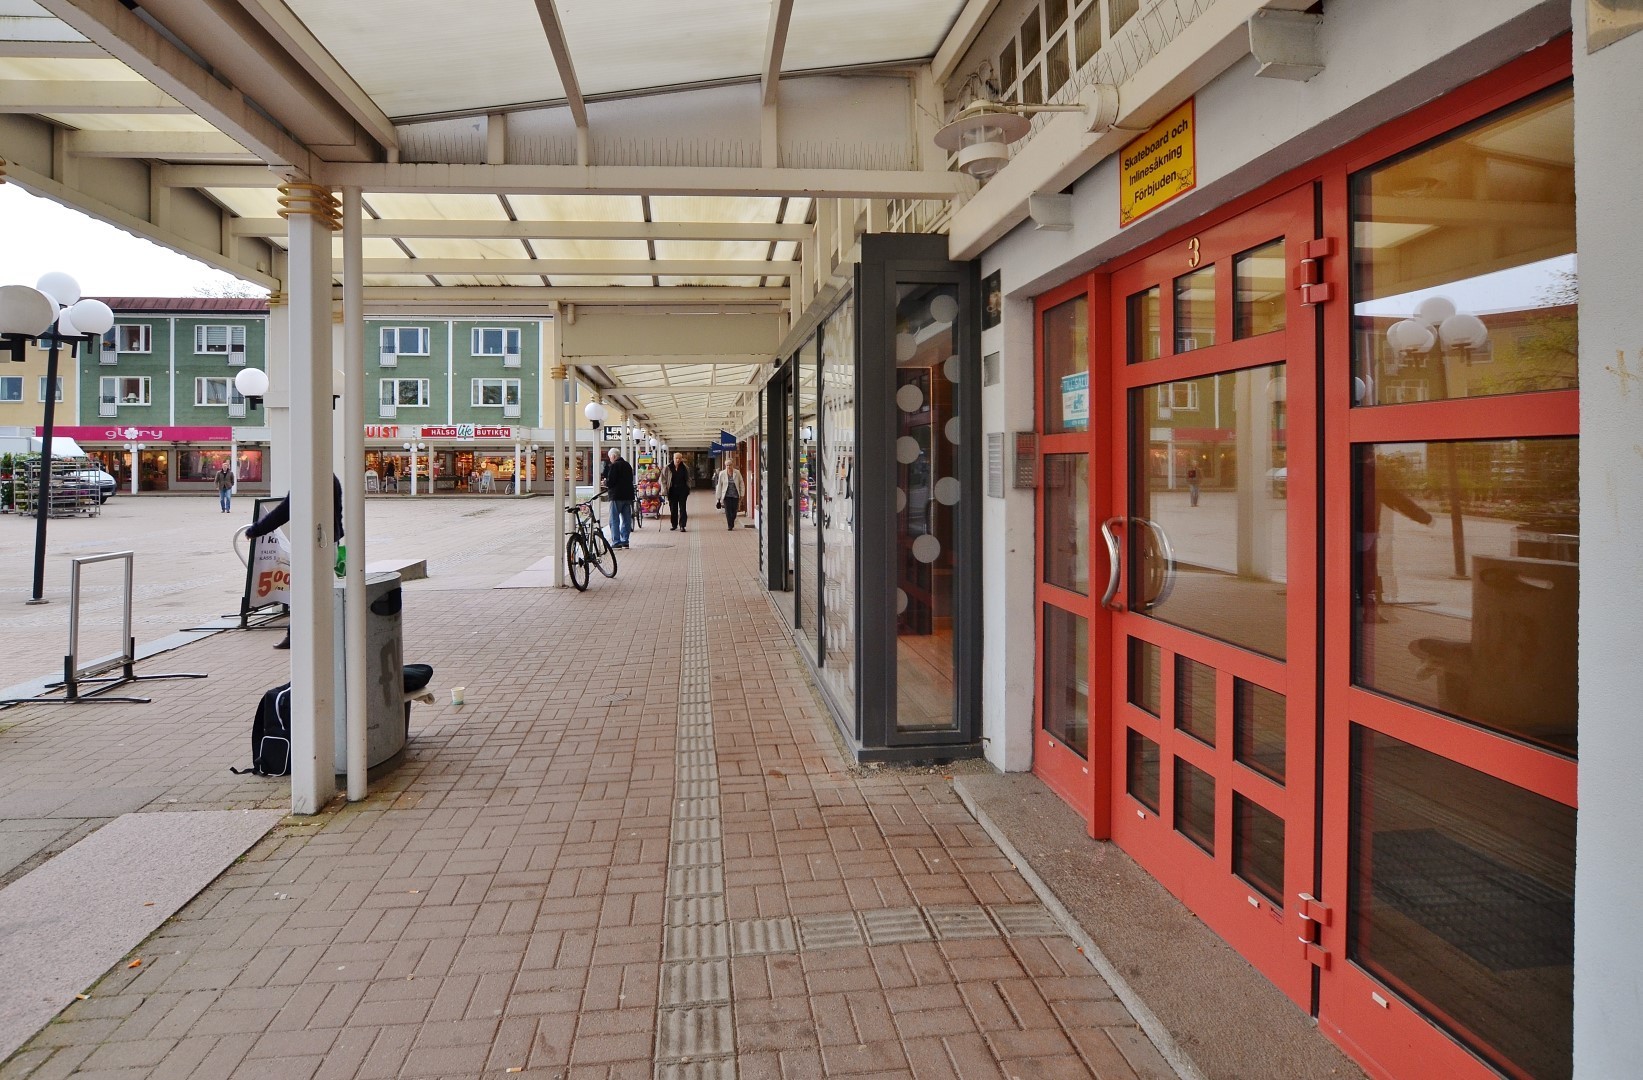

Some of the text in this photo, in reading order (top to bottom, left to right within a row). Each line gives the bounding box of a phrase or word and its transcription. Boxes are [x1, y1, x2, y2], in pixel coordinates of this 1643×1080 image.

[1123, 119, 1188, 171] Skateboard och
[1129, 143, 1183, 186] Inlinesåkning
[1134, 169, 1177, 204] Förbjuden
[1188, 237, 1201, 268] 3
[105, 427, 163, 440] glory
[366, 426, 399, 438] UIST
[431, 428, 455, 436] HÄLSO
